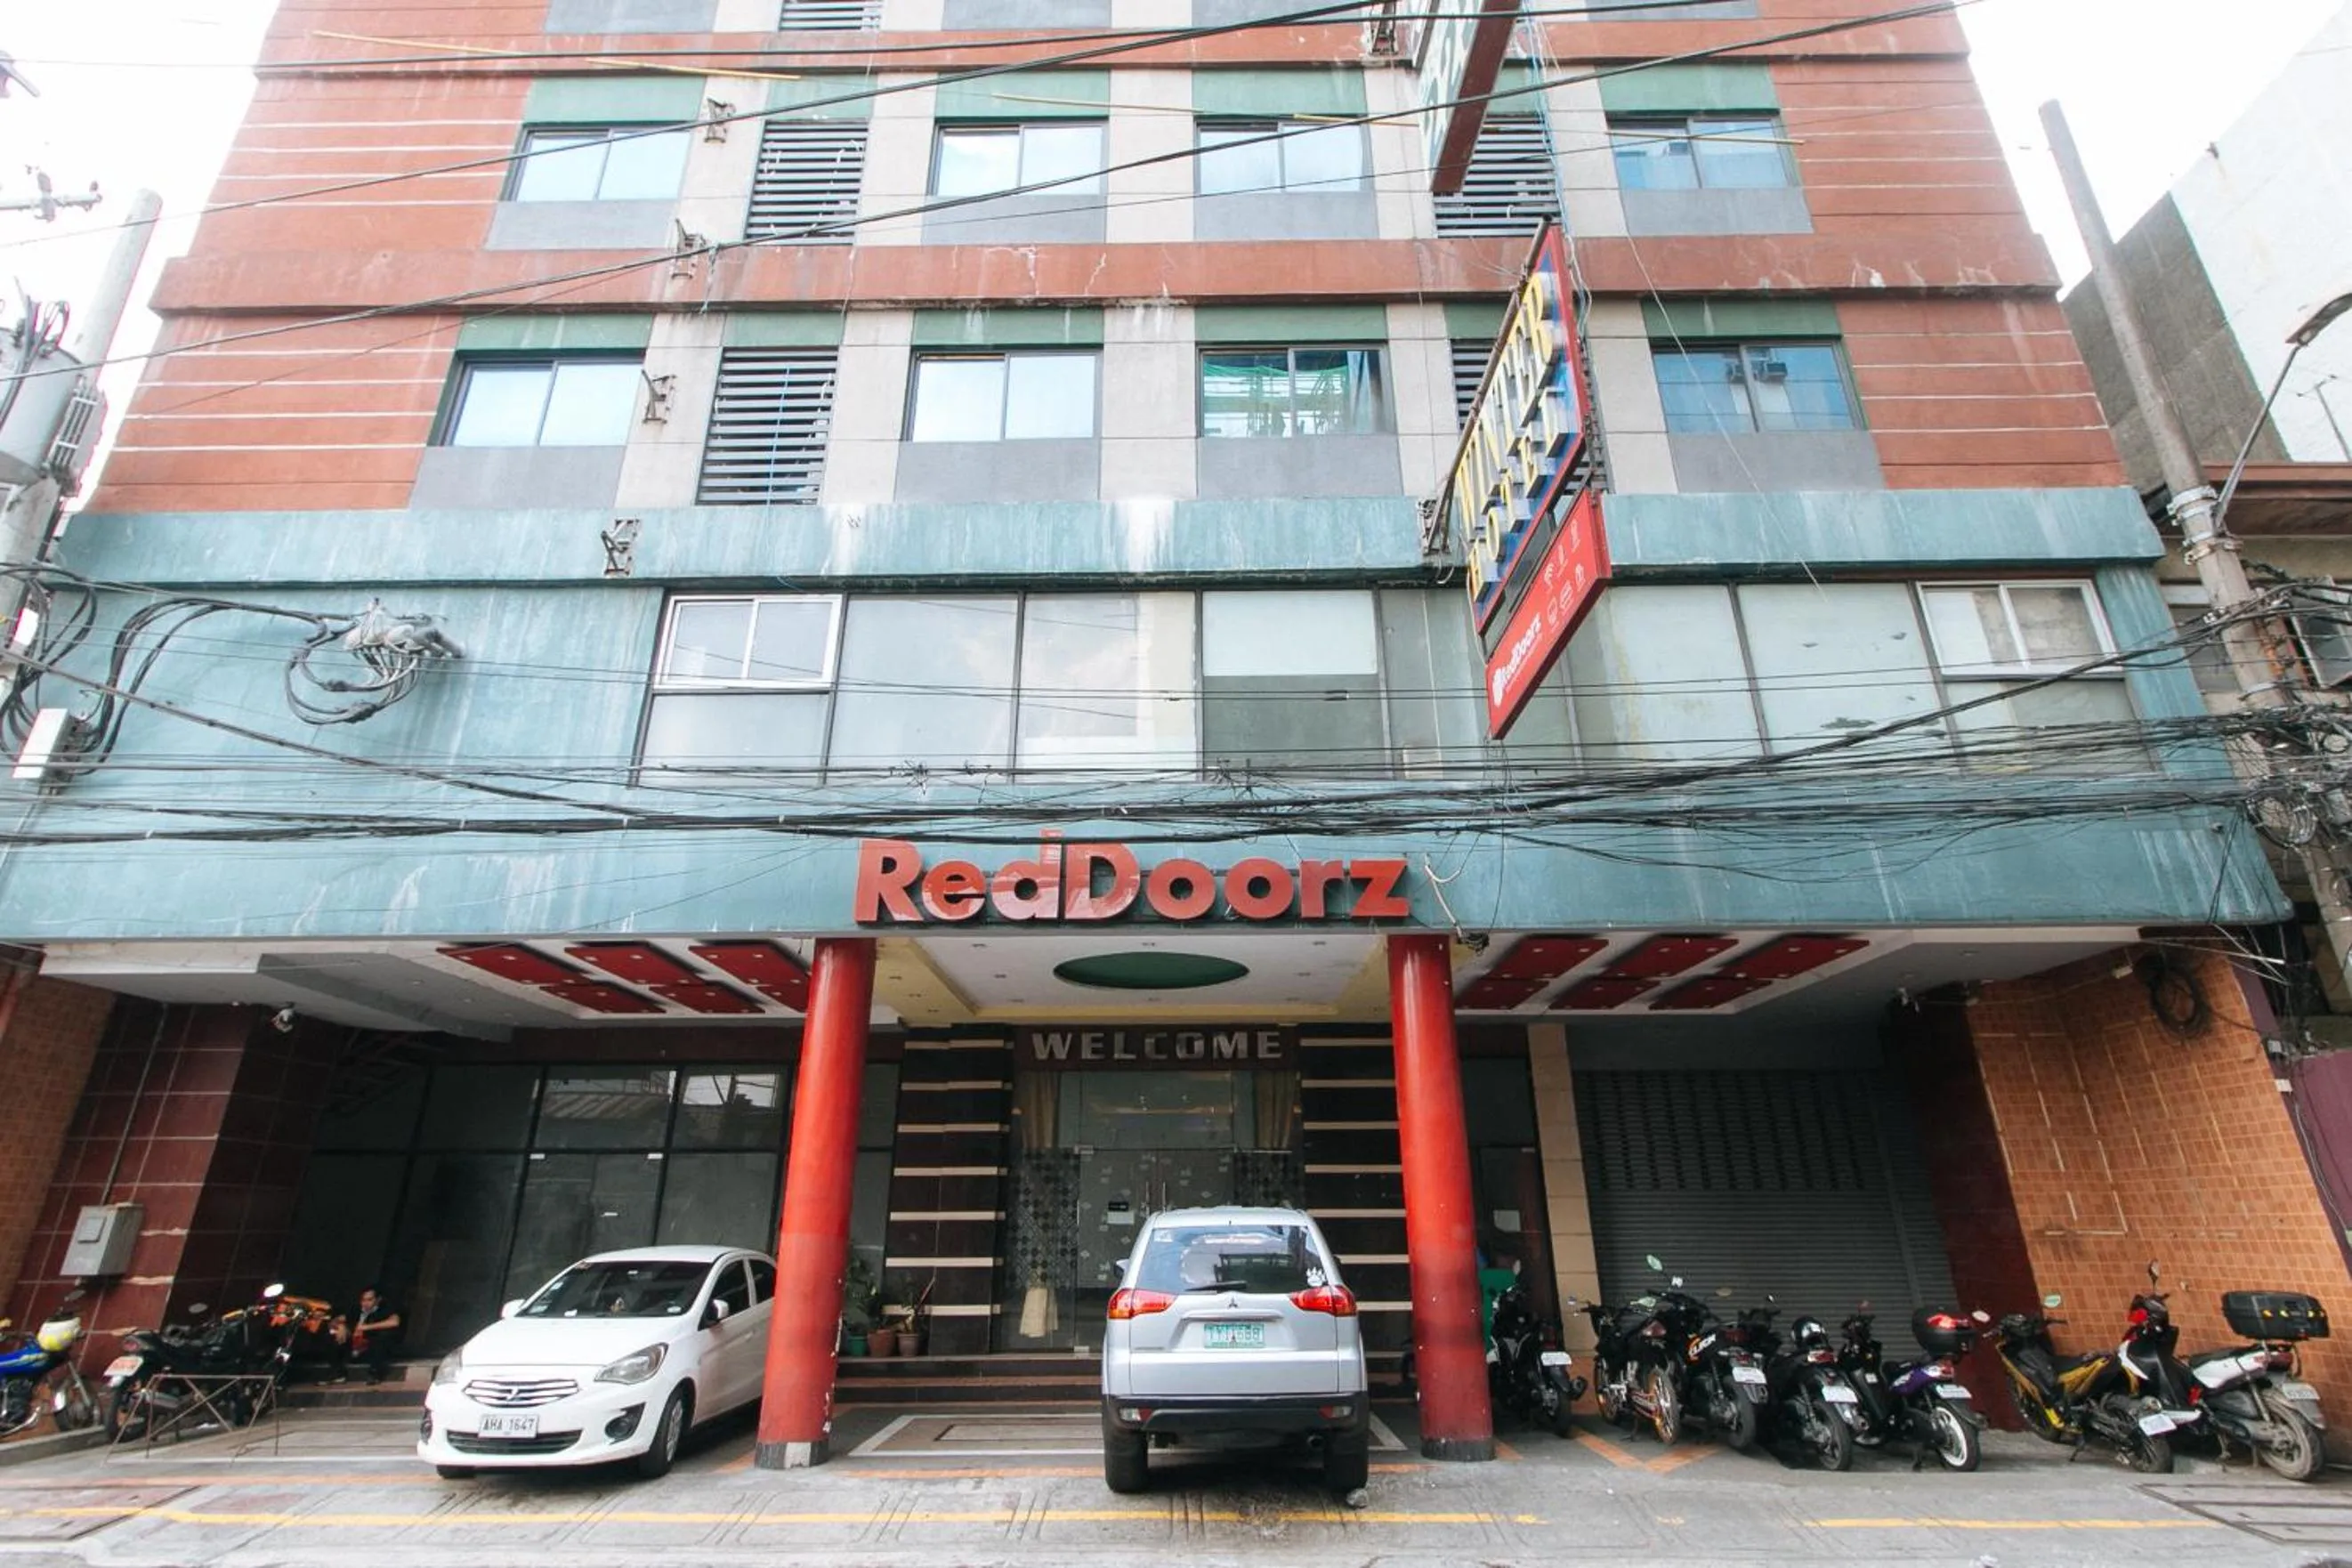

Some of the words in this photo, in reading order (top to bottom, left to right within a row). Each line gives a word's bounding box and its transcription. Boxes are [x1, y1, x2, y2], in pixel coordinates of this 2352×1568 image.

[1468, 387, 1564, 603] HOTEL
[855, 829, 1410, 924] RedDoorz
[1031, 1030, 1283, 1062] WELCOME
